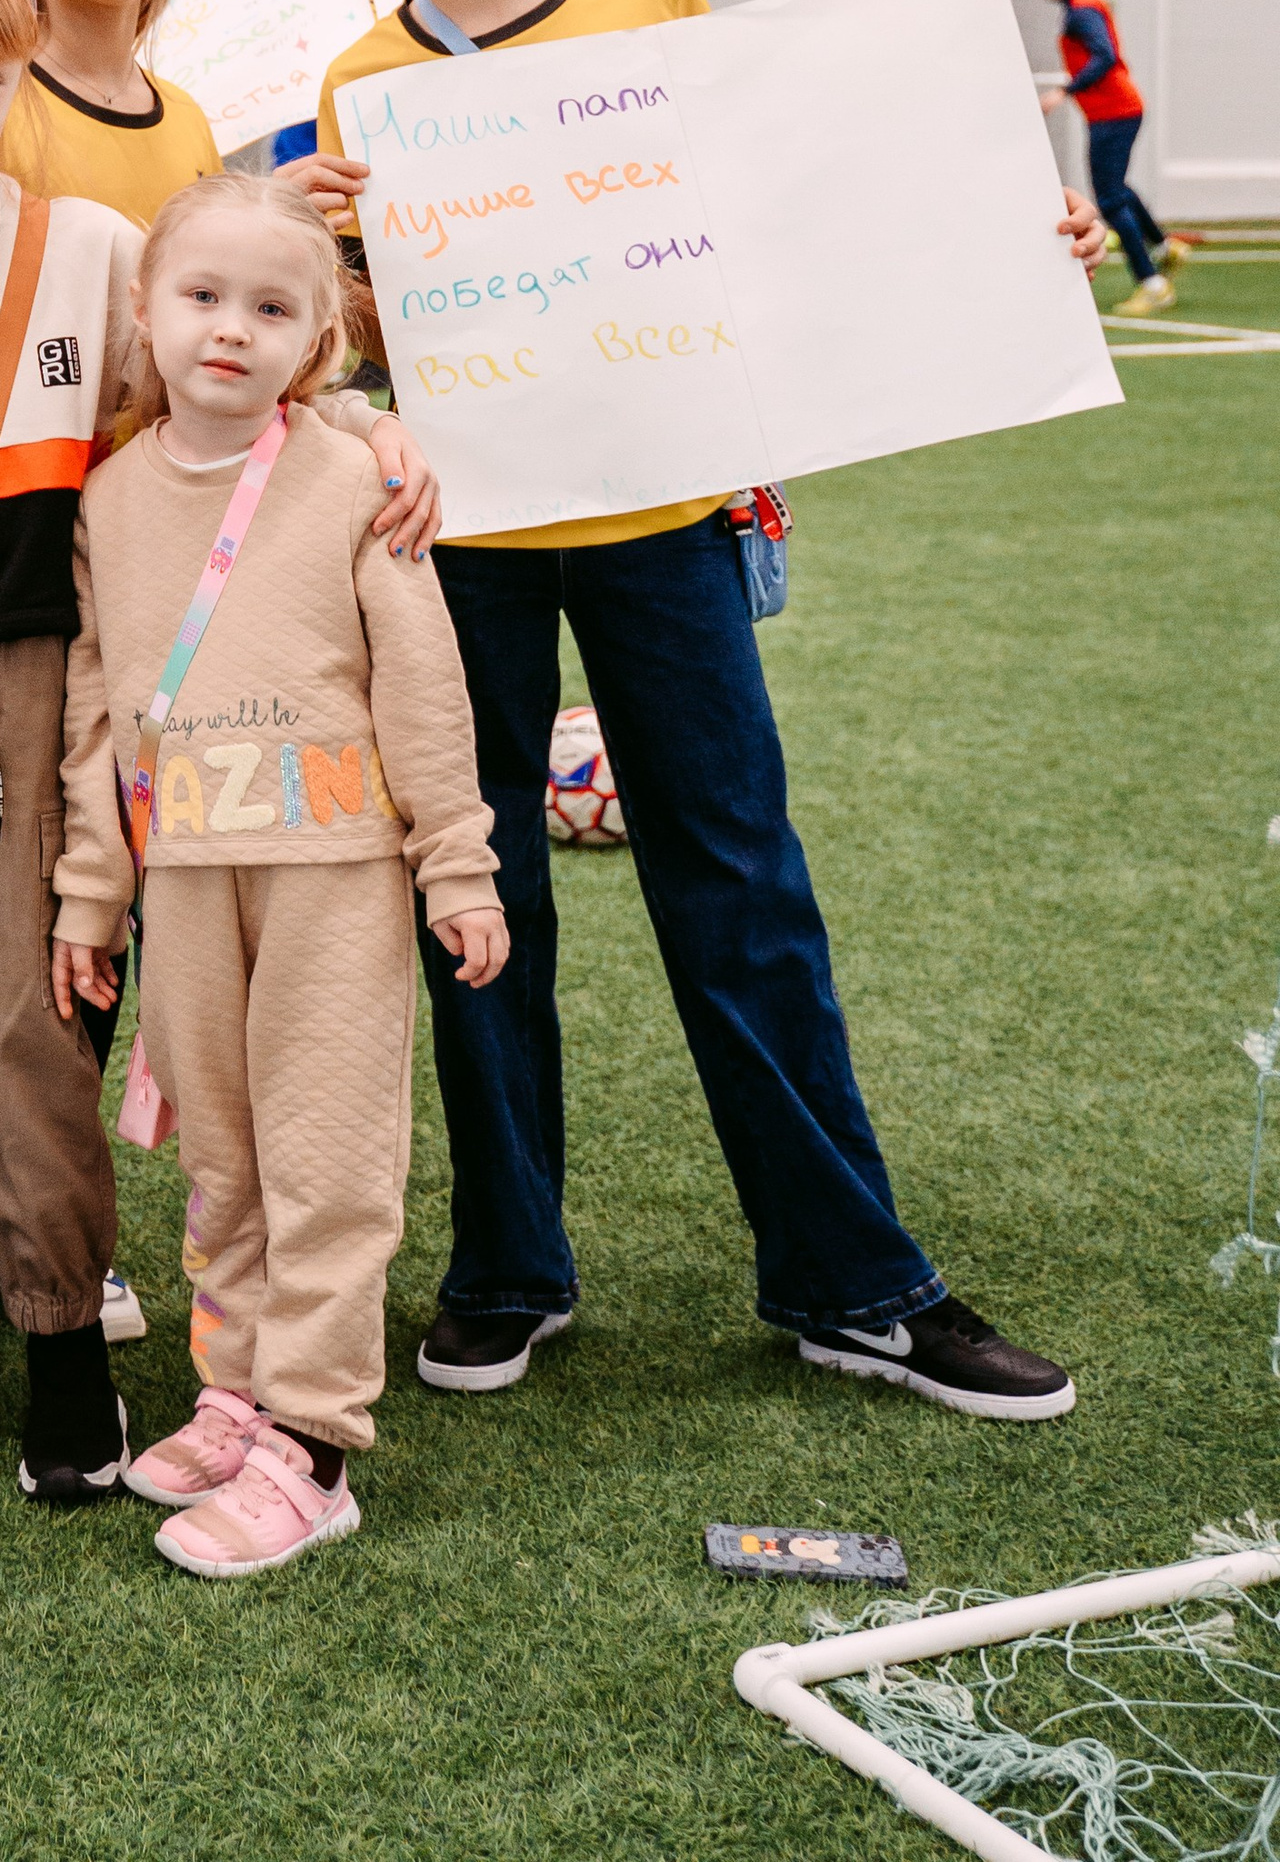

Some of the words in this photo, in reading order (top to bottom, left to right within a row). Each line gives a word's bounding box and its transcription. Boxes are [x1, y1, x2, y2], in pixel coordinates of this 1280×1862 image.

[351, 91, 528, 166] Наши
[558, 85, 670, 126] папы
[624, 233, 715, 272] они
